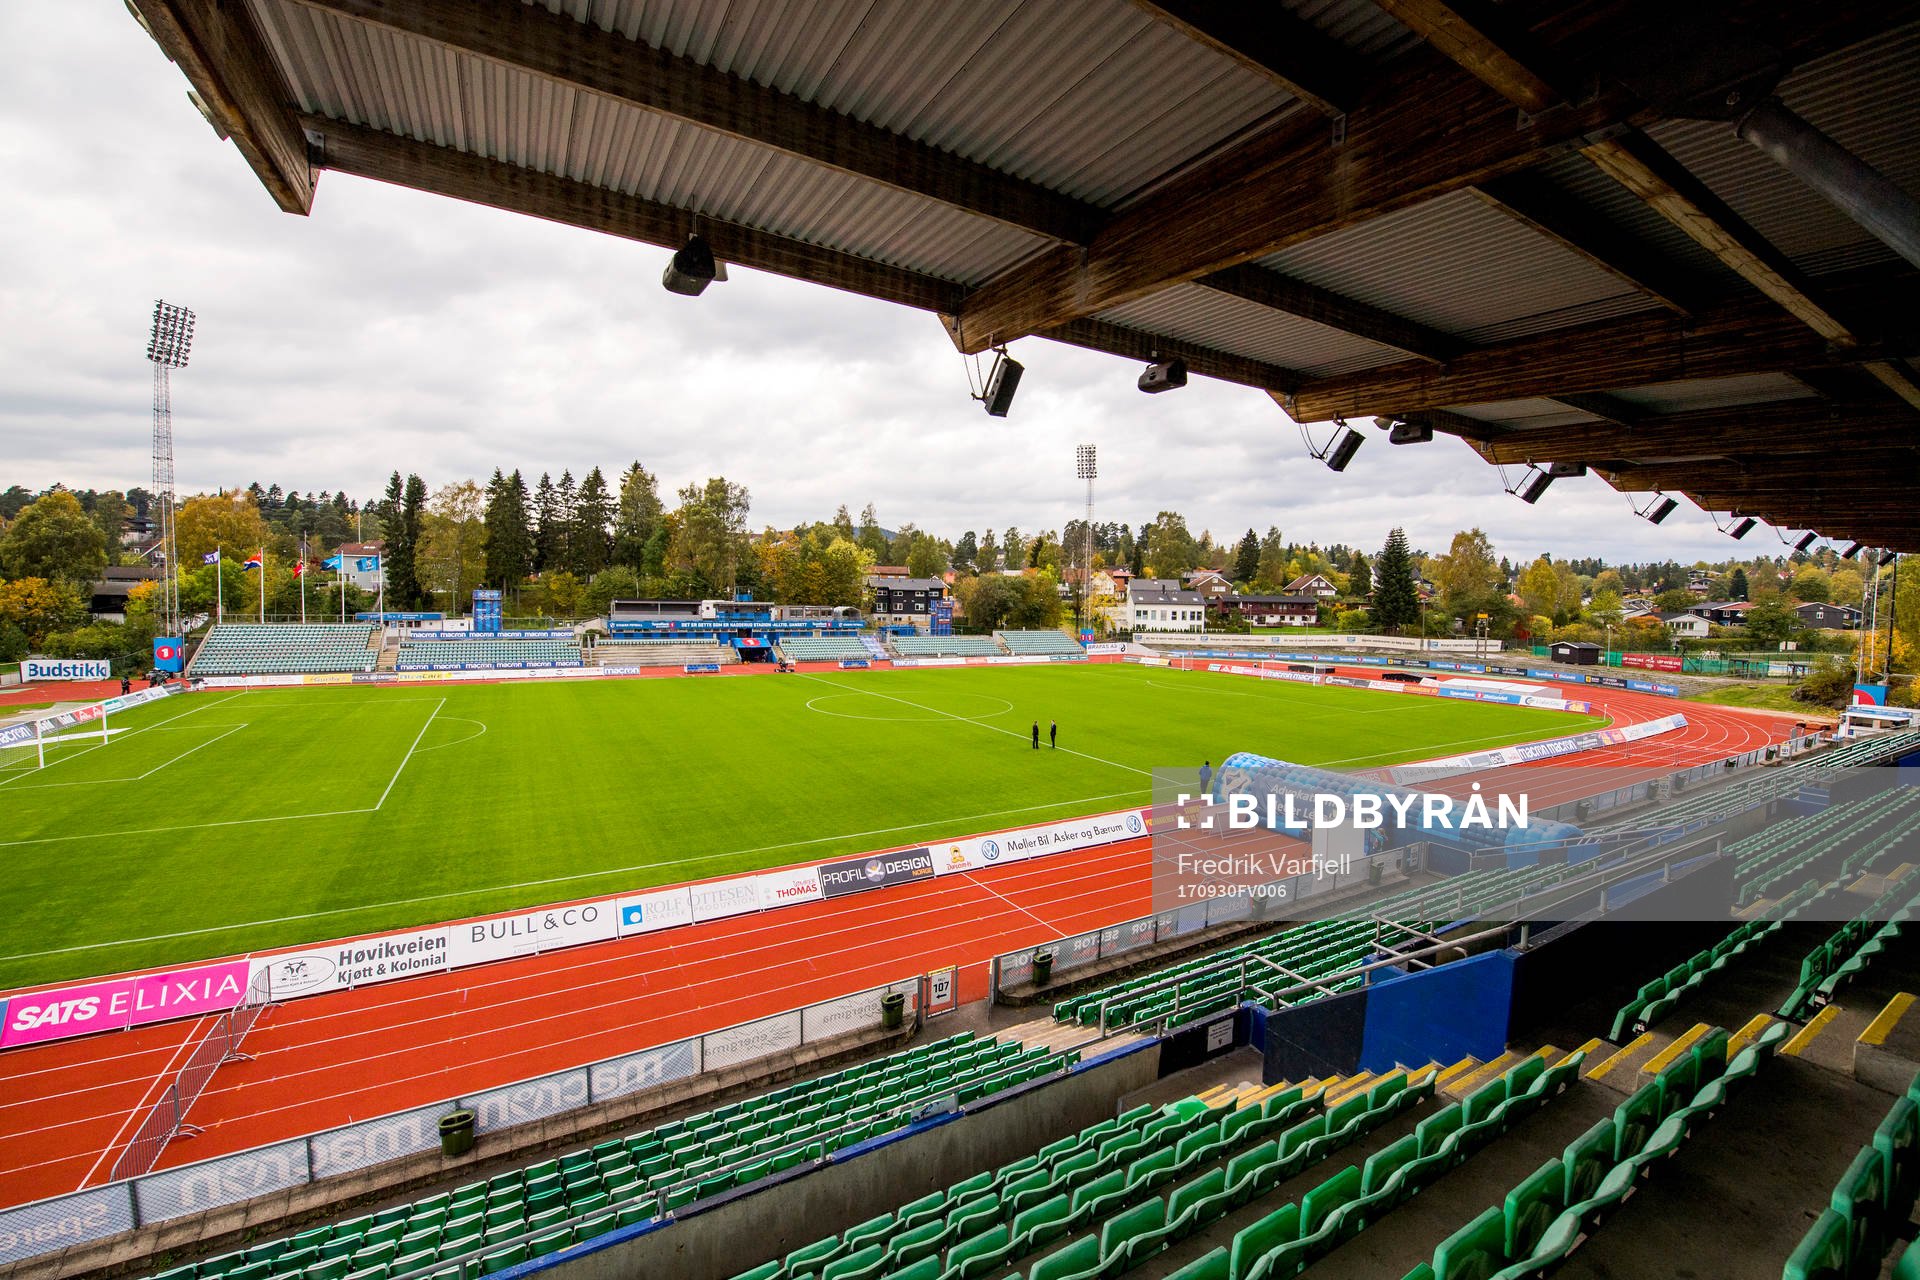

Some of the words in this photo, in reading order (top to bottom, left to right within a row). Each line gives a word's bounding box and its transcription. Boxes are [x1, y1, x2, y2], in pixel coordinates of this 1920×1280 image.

[0, 726, 32, 744] acron
[1007, 840, 1037, 852] Møller
[1038, 835, 1050, 846] Bil
[1054, 831, 1078, 843] Asker
[1080, 831, 1092, 839] og
[1093, 823, 1123, 836] Bærum
[823, 867, 866, 887] PROFIL
[885, 855, 931, 874] DESIGN
[912, 868, 933, 877] NORGE
[646, 899, 682, 915] ROLF
[687, 884, 754, 907] OTTESEN
[776, 884, 817, 899] THOMAS
[339, 936, 446, 966] Høvikveien
[337, 967, 373, 984] Kjøtt
[376, 964, 387, 975] &
[391, 952, 446, 973] Kolonial
[933, 981, 949, 993] 107
[13, 996, 100, 1031] SATS
[109, 974, 240, 1016] ELIXIA
